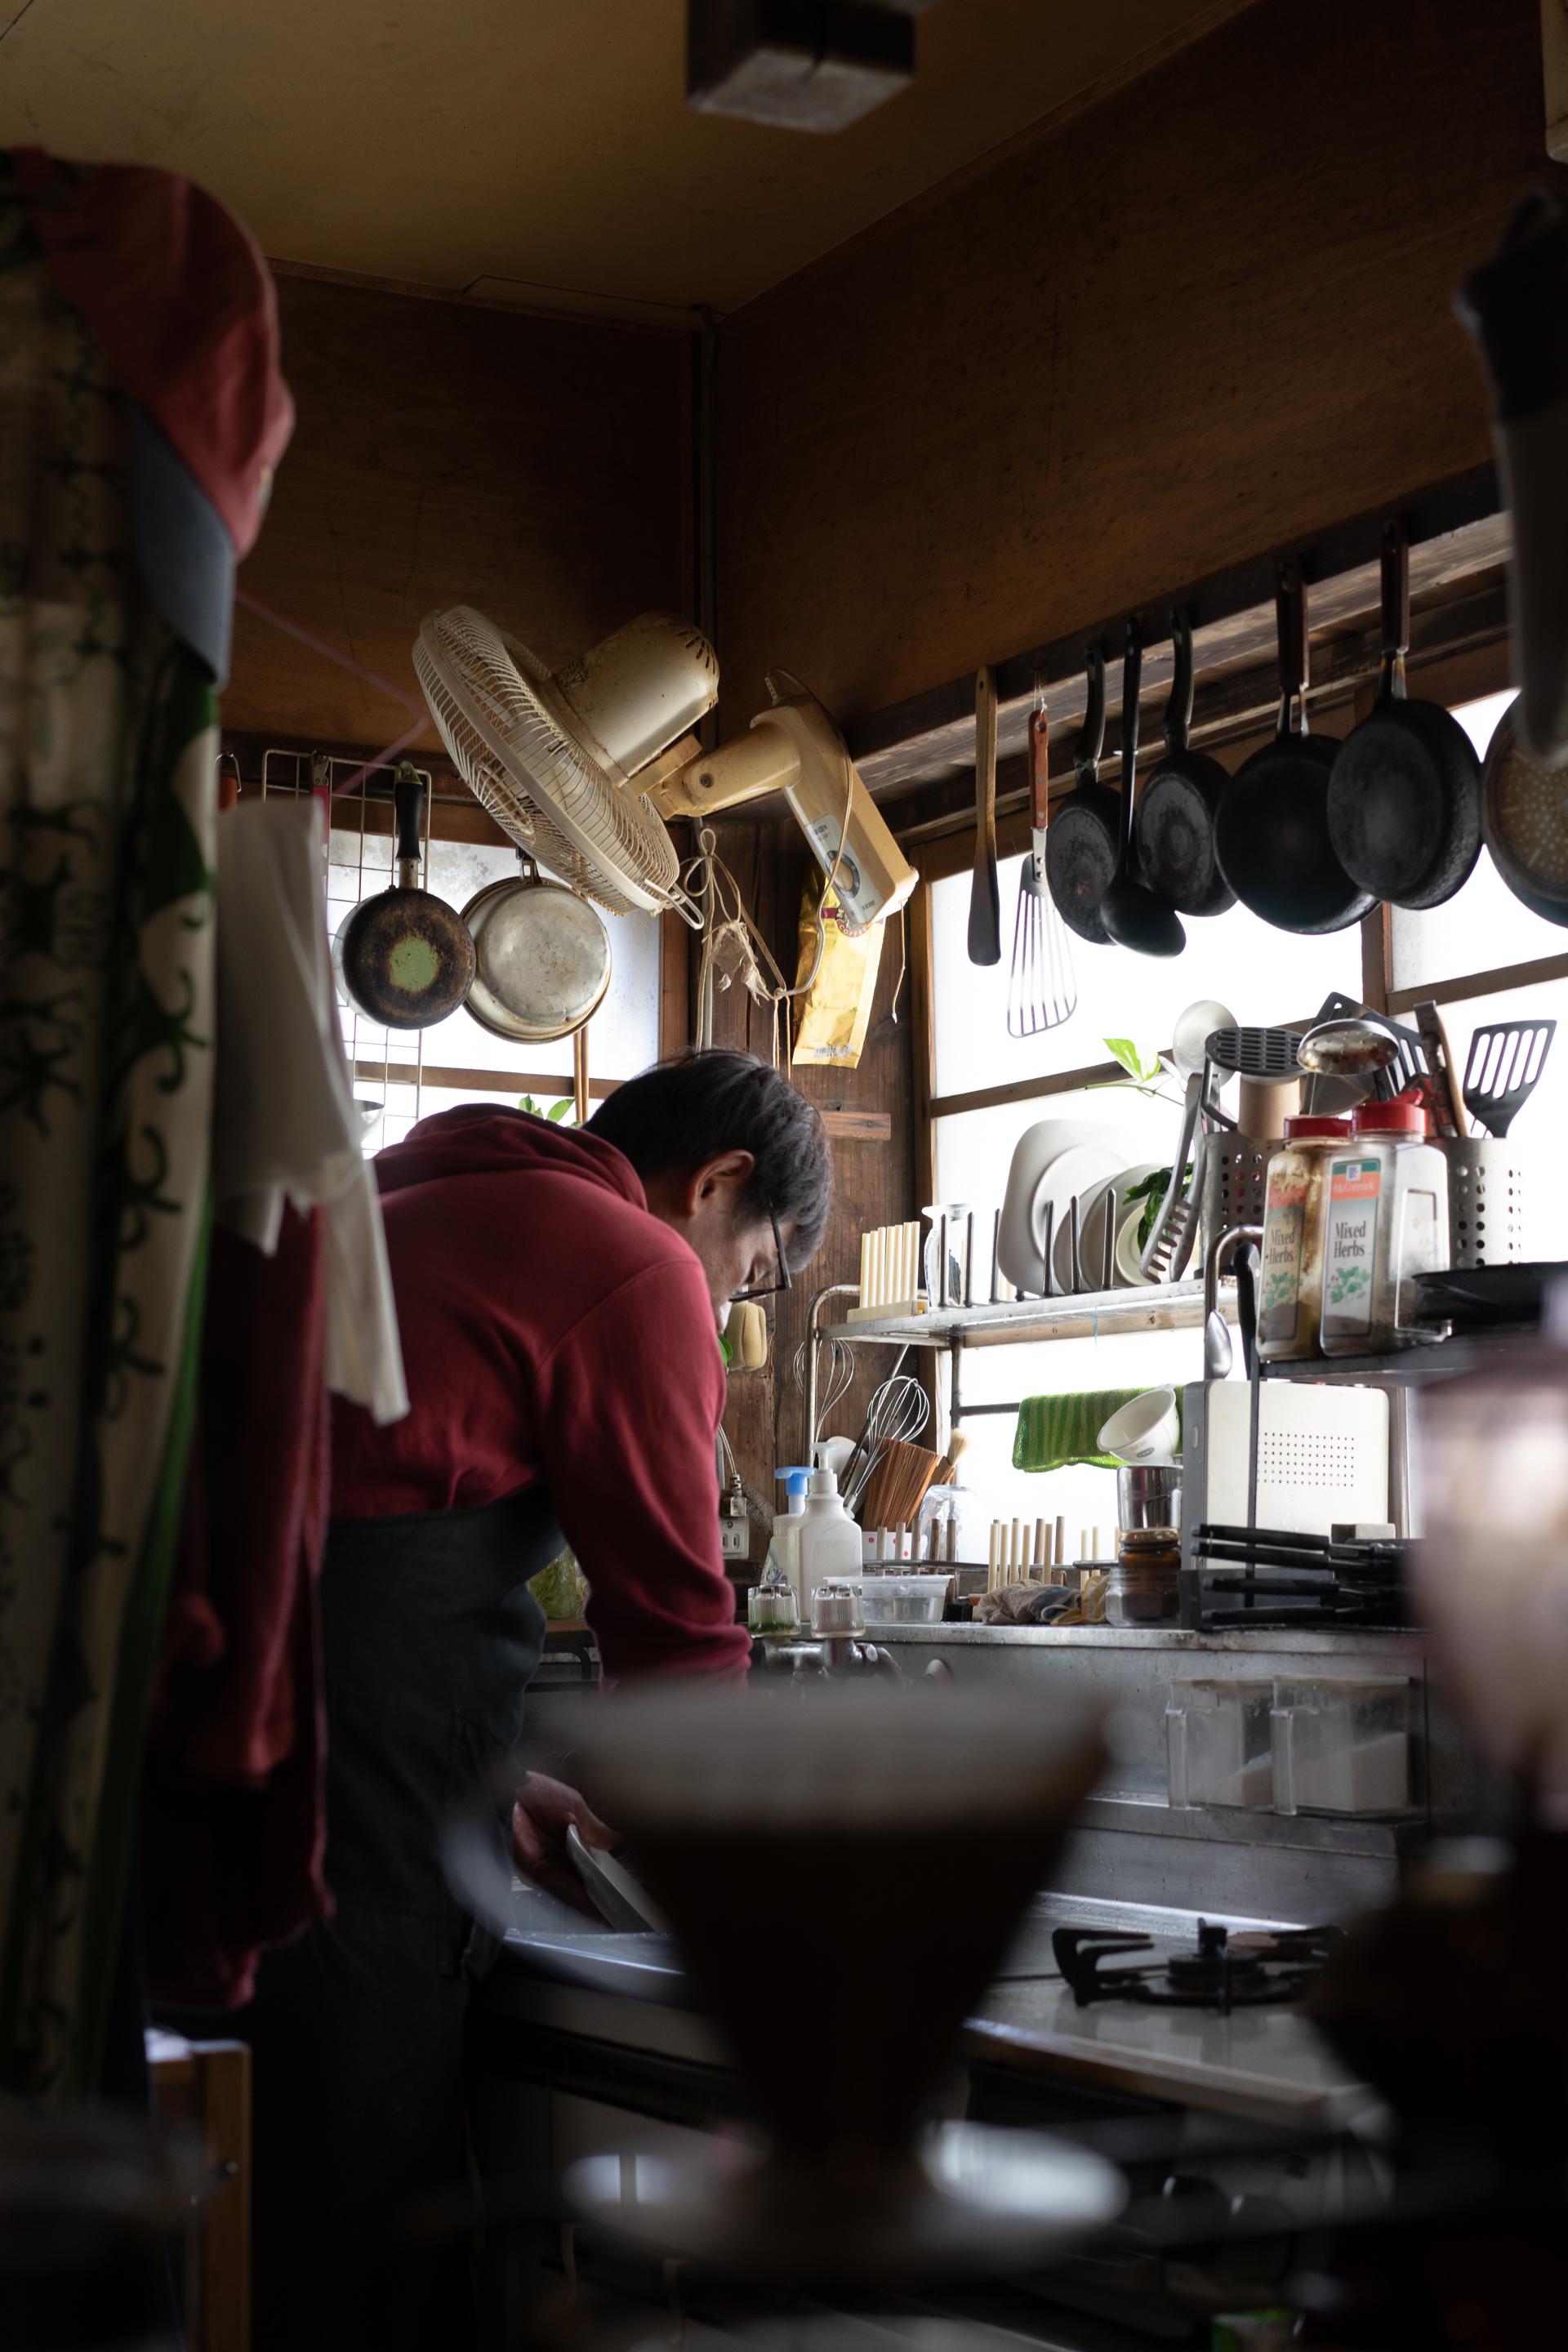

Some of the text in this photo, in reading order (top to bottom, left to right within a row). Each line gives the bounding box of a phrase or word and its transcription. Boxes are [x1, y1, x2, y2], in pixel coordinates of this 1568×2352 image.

[1332, 1181, 1375, 1194] McCormick
[1271, 1228, 1295, 1246] Mixed
[1335, 1221, 1366, 1239] Mixed
[1268, 1246, 1294, 1264] Herbs
[1334, 1241, 1365, 1258] Herbs
